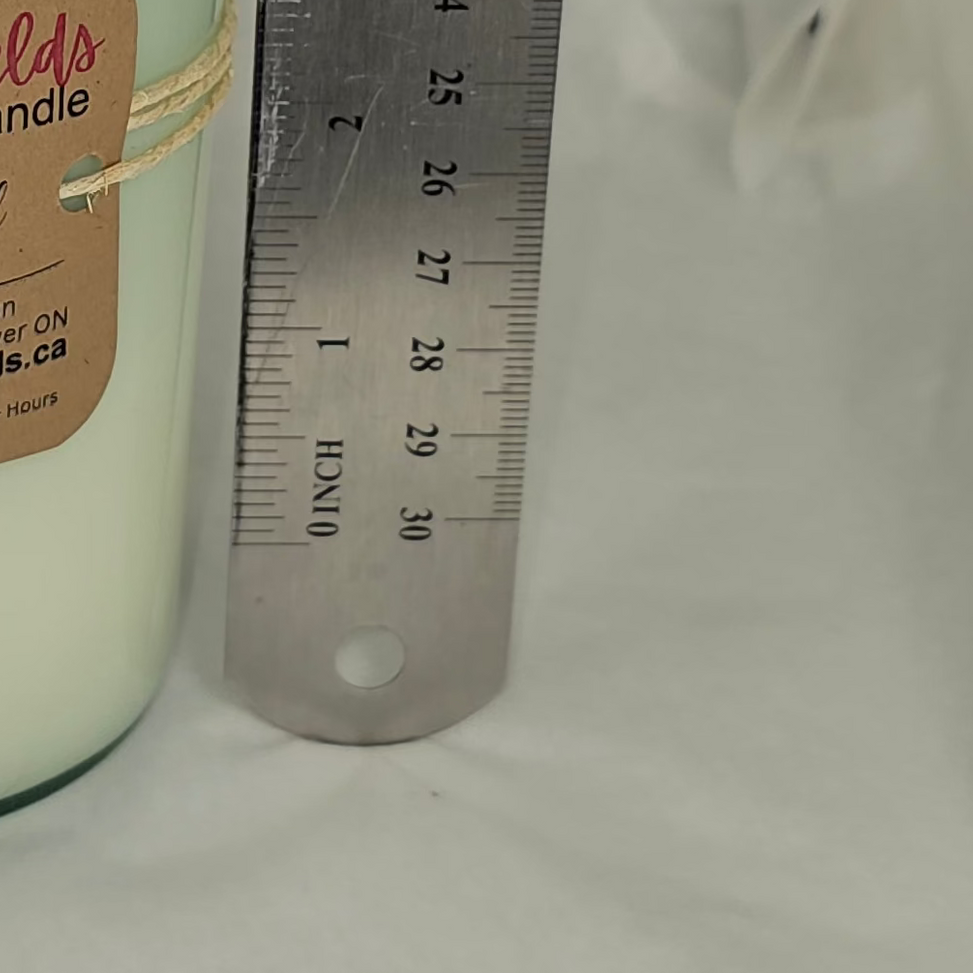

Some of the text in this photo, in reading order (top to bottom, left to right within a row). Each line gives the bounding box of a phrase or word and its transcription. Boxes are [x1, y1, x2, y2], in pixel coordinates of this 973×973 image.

[429, 69, 465, 107] 25
[328, 114, 363, 132] 2
[421, 159, 458, 197] 26
[415, 248, 451, 286] 27
[34, 307, 69, 335] ON
[317, 336, 351, 350] 1
[409, 336, 445, 372] 28
[6, 390, 58, 418] Hours
[405, 422, 439, 458] 29
[305, 438, 345, 538] 0 INCH
[398, 506, 433, 542] 30
